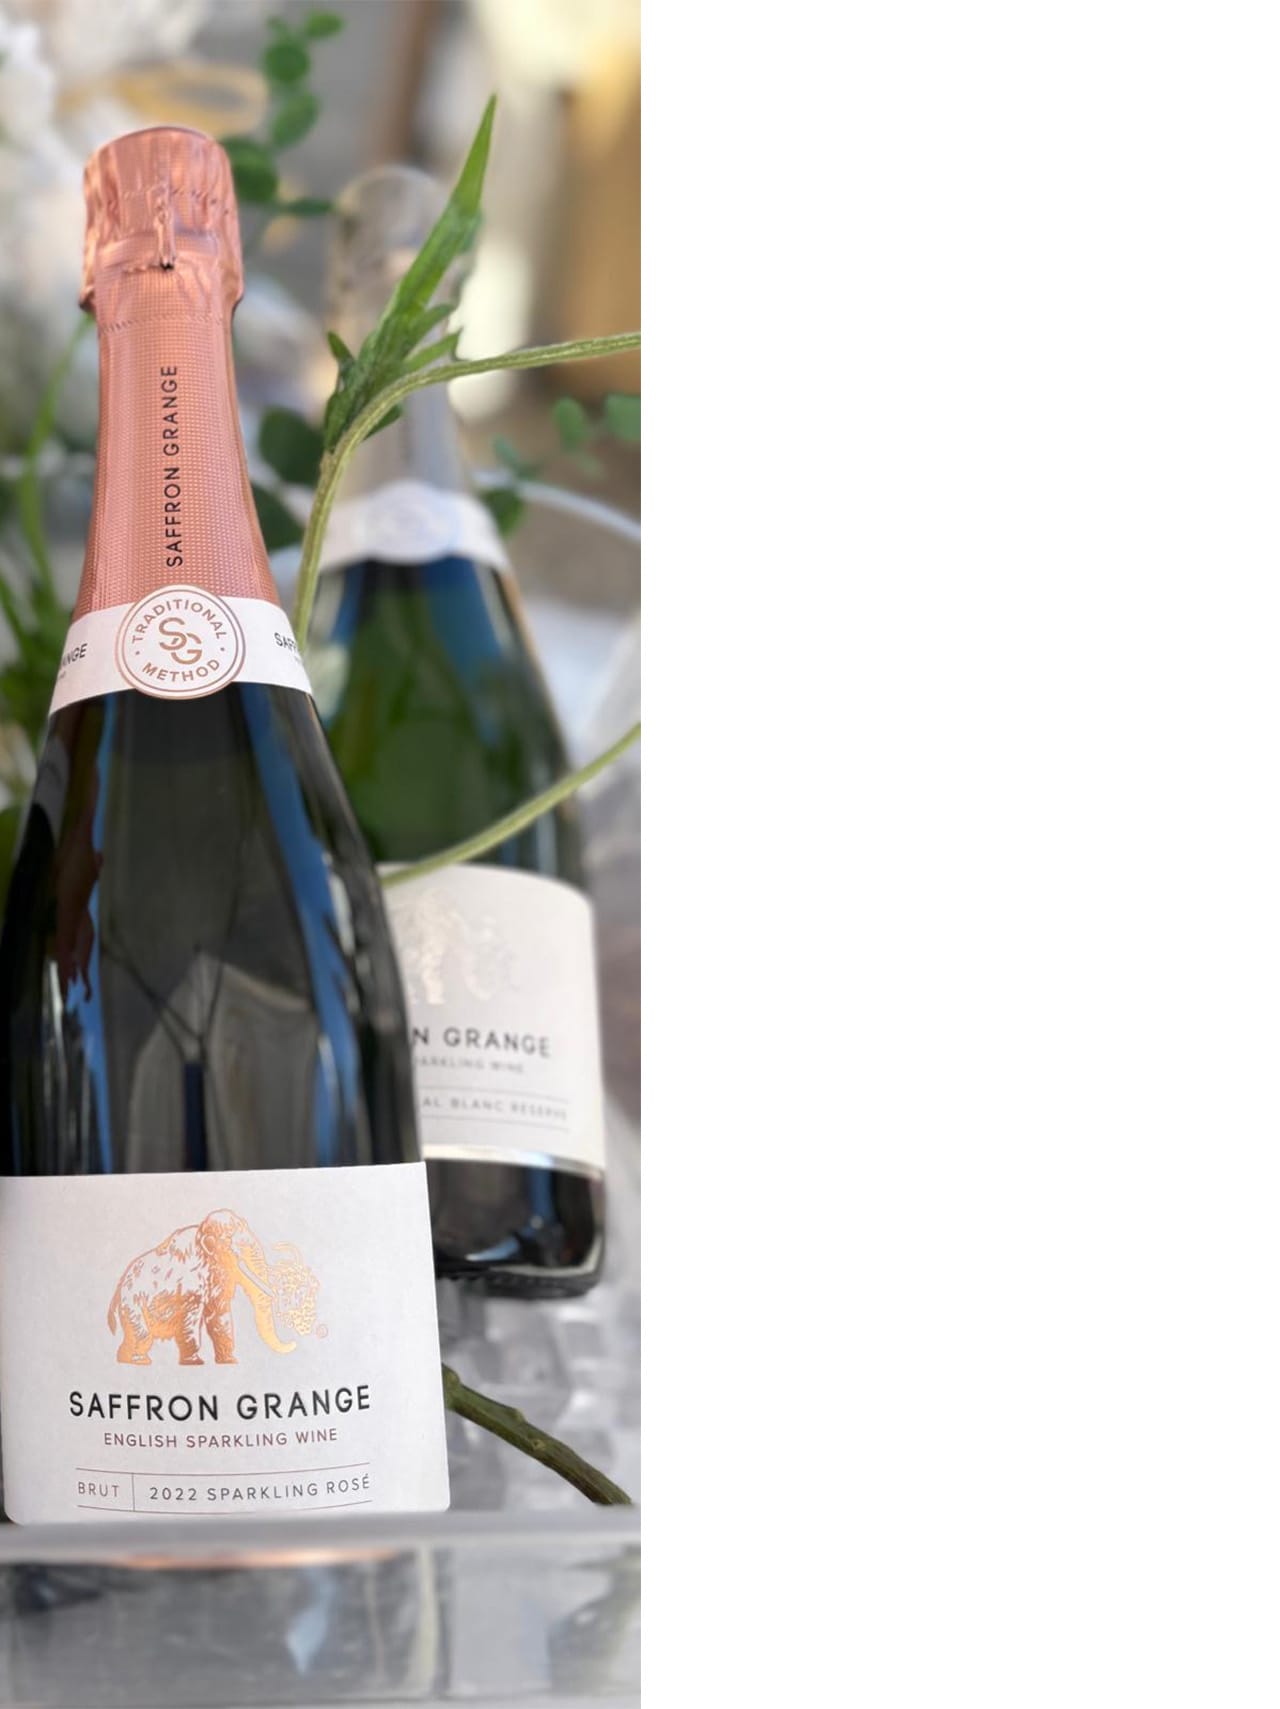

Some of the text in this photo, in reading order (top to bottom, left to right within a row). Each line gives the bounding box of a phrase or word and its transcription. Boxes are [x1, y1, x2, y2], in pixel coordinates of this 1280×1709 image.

[160, 365, 183, 568] SAFFRON GRANGE
[132, 599, 228, 644] TRADITIONAL
[142, 658, 220, 682] METHOD
[443, 1026, 551, 1059] GRANGE
[69, 1384, 371, 1422] SAFFRON GRANGE
[103, 1428, 338, 1448] ENGLISH SPARKLING WINE
[77, 1481, 120, 1498] BRUT
[149, 1473, 371, 1501] 2022 SPARKLING ROSÉ
